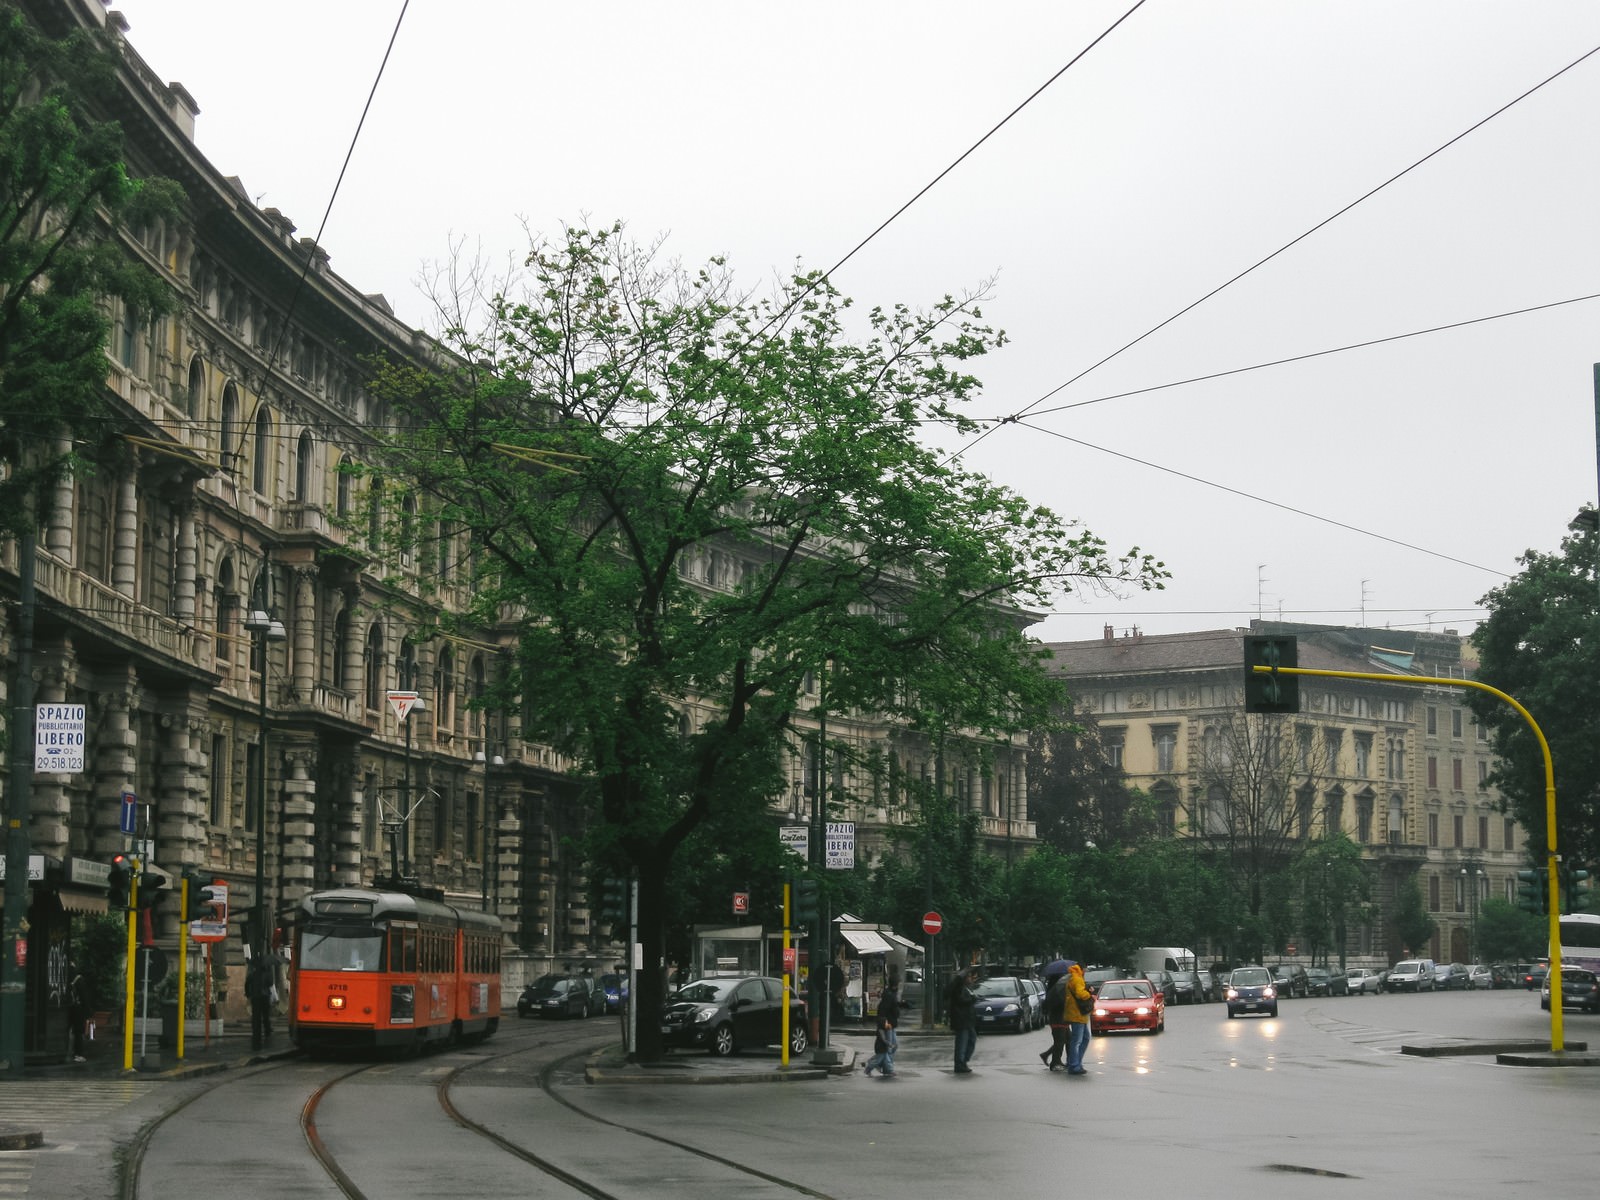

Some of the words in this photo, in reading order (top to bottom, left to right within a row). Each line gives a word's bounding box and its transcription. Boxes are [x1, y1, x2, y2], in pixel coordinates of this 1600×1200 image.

[39, 707, 84, 720] SPAZIO
[38, 722, 84, 730] PUBBLICITARIO
[38, 732, 83, 745] LIBERO
[37, 757, 83, 769] 29.518.123
[826, 841, 853, 850] IBERO
